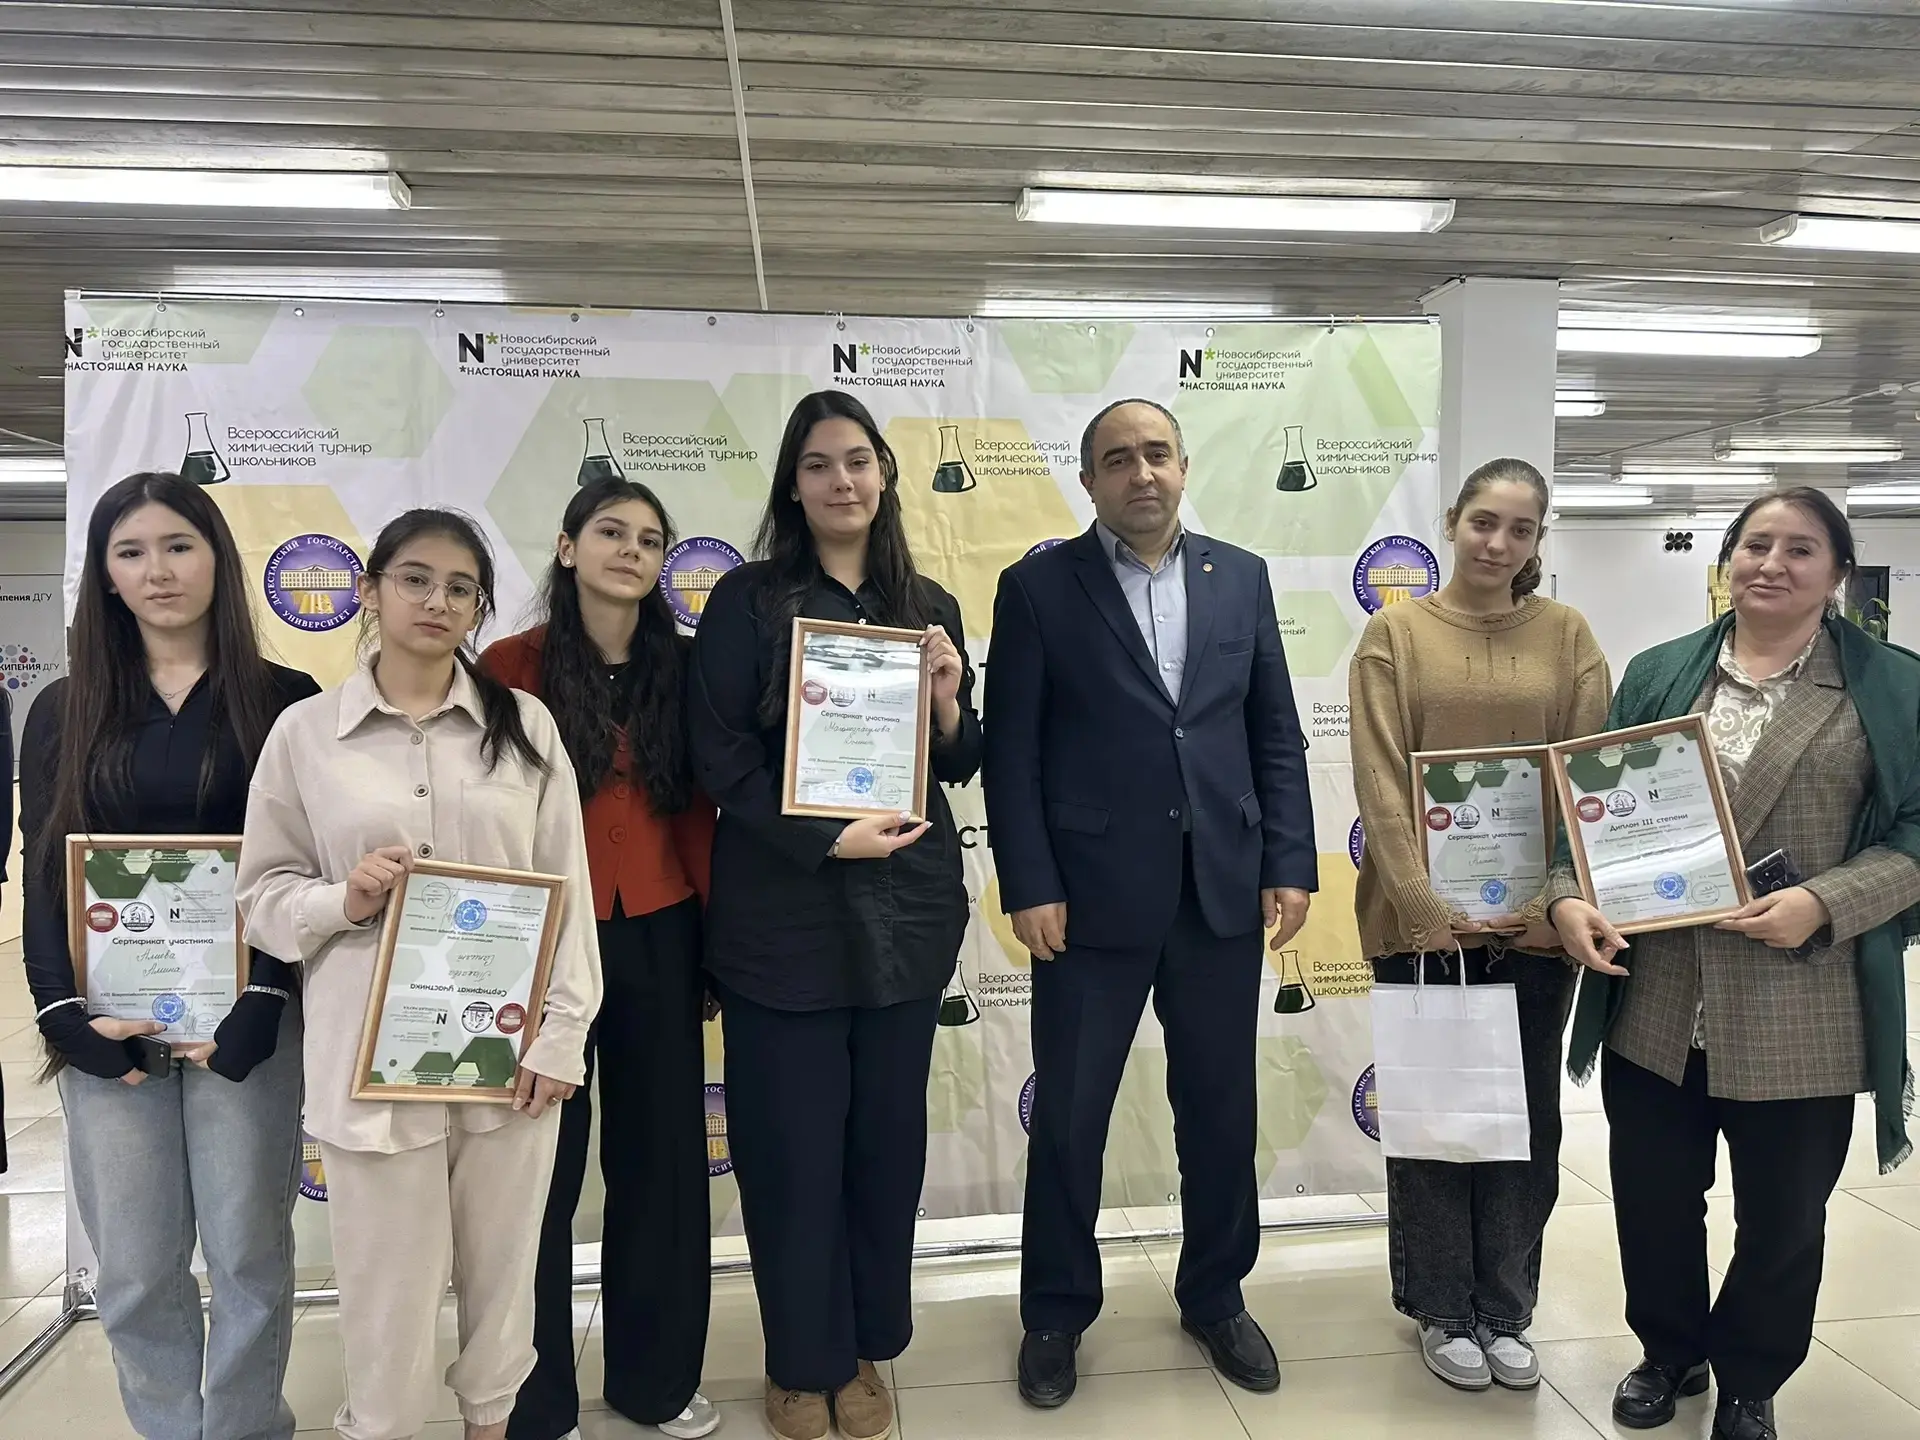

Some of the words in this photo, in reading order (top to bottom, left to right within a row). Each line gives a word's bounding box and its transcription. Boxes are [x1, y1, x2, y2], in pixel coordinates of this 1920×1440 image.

[101, 327, 206, 339] Новосибирский
[101, 340, 220, 350] государственный
[500, 334, 597, 345] Новосибирский
[102, 350, 188, 361] университет
[500, 346, 610, 357] государственный
[872, 345, 961, 356] Новосибирский
[1216, 349, 1301, 360] Новосибирский
[148, 362, 188, 372] НАУКА
[501, 357, 580, 366] университет
[872, 356, 973, 367] государственный
[1216, 360, 1313, 370] государственный
[543, 369, 581, 378] НАУКА
[872, 367, 944, 376] университет
[1215, 370, 1285, 380] университет
[911, 379, 945, 387] НАУКА
[1251, 381, 1286, 390] НАУКА
[227, 426, 339, 441] Всероссийский
[622, 432, 727, 446] Всероссийский
[227, 441, 314, 452] химический
[319, 443, 372, 455] турнир
[974, 439, 1070, 452] Всероссийский
[1316, 438, 1412, 451] Всероссийский
[622, 447, 704, 458] химический
[708, 449, 758, 461] турнир
[974, 453, 1048, 463] химический
[1053, 454, 1081, 466] турн
[1316, 451, 1389, 462] химический
[1394, 453, 1438, 464] турнир
[228, 457, 317, 466] школьников
[623, 461, 706, 471] школьников
[974, 467, 1050, 476] школьников
[1316, 465, 1390, 474] школьников
[697, 539, 743, 566] ГОСУДАРСТ
[267, 540, 300, 606] ДАГЕСТАНСКИЙ
[1356, 540, 1386, 600] ДАГЕСТАНСКИЙ
[1392, 538, 1437, 592] ГОСУДАРСТВЕННЫ
[32, 592, 52, 602] ДГУ
[282, 608, 350, 629] УНИВЕРСИТЕТ
[42, 663, 60, 671] ДГУ
[821, 710, 862, 720] Сертификат
[865, 715, 900, 723] участника
[1312, 717, 1350, 725] химич
[1312, 728, 1349, 737] школь
[1648, 789, 1659, 800] N
[1491, 808, 1500, 817] N
[1642, 818, 1653, 826] III
[1656, 813, 1688, 823] степени
[170, 908, 180, 919] N
[112, 937, 165, 946] Сертификат
[169, 938, 214, 946] участника
[1313, 974, 1374, 983] химически
[410, 984, 454, 992] участника
[457, 987, 507, 997] Сертификат
[979, 998, 1031, 1007] школьни
[436, 1013, 447, 1024] N
